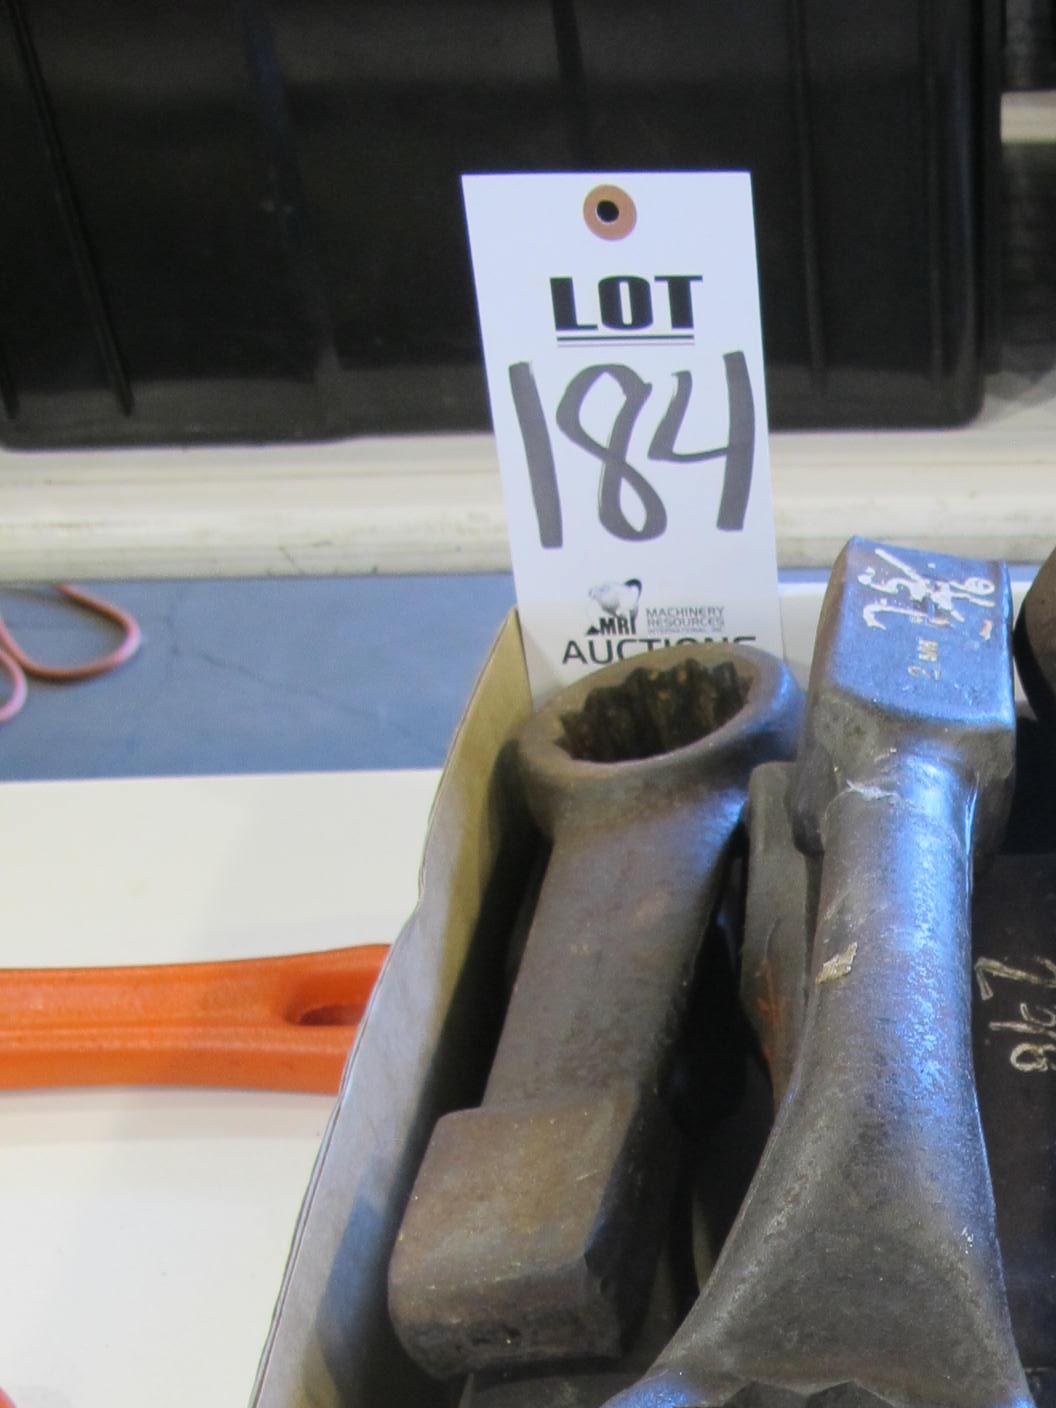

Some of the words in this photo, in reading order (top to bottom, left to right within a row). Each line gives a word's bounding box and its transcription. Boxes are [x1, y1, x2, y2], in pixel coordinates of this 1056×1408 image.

[549, 274, 703, 332] LOT
[508, 350, 756, 549] 184
[645, 606, 726, 618] MACHINERY
[647, 616, 725, 628] RESOURCES
[600, 614, 638, 635] MRI
